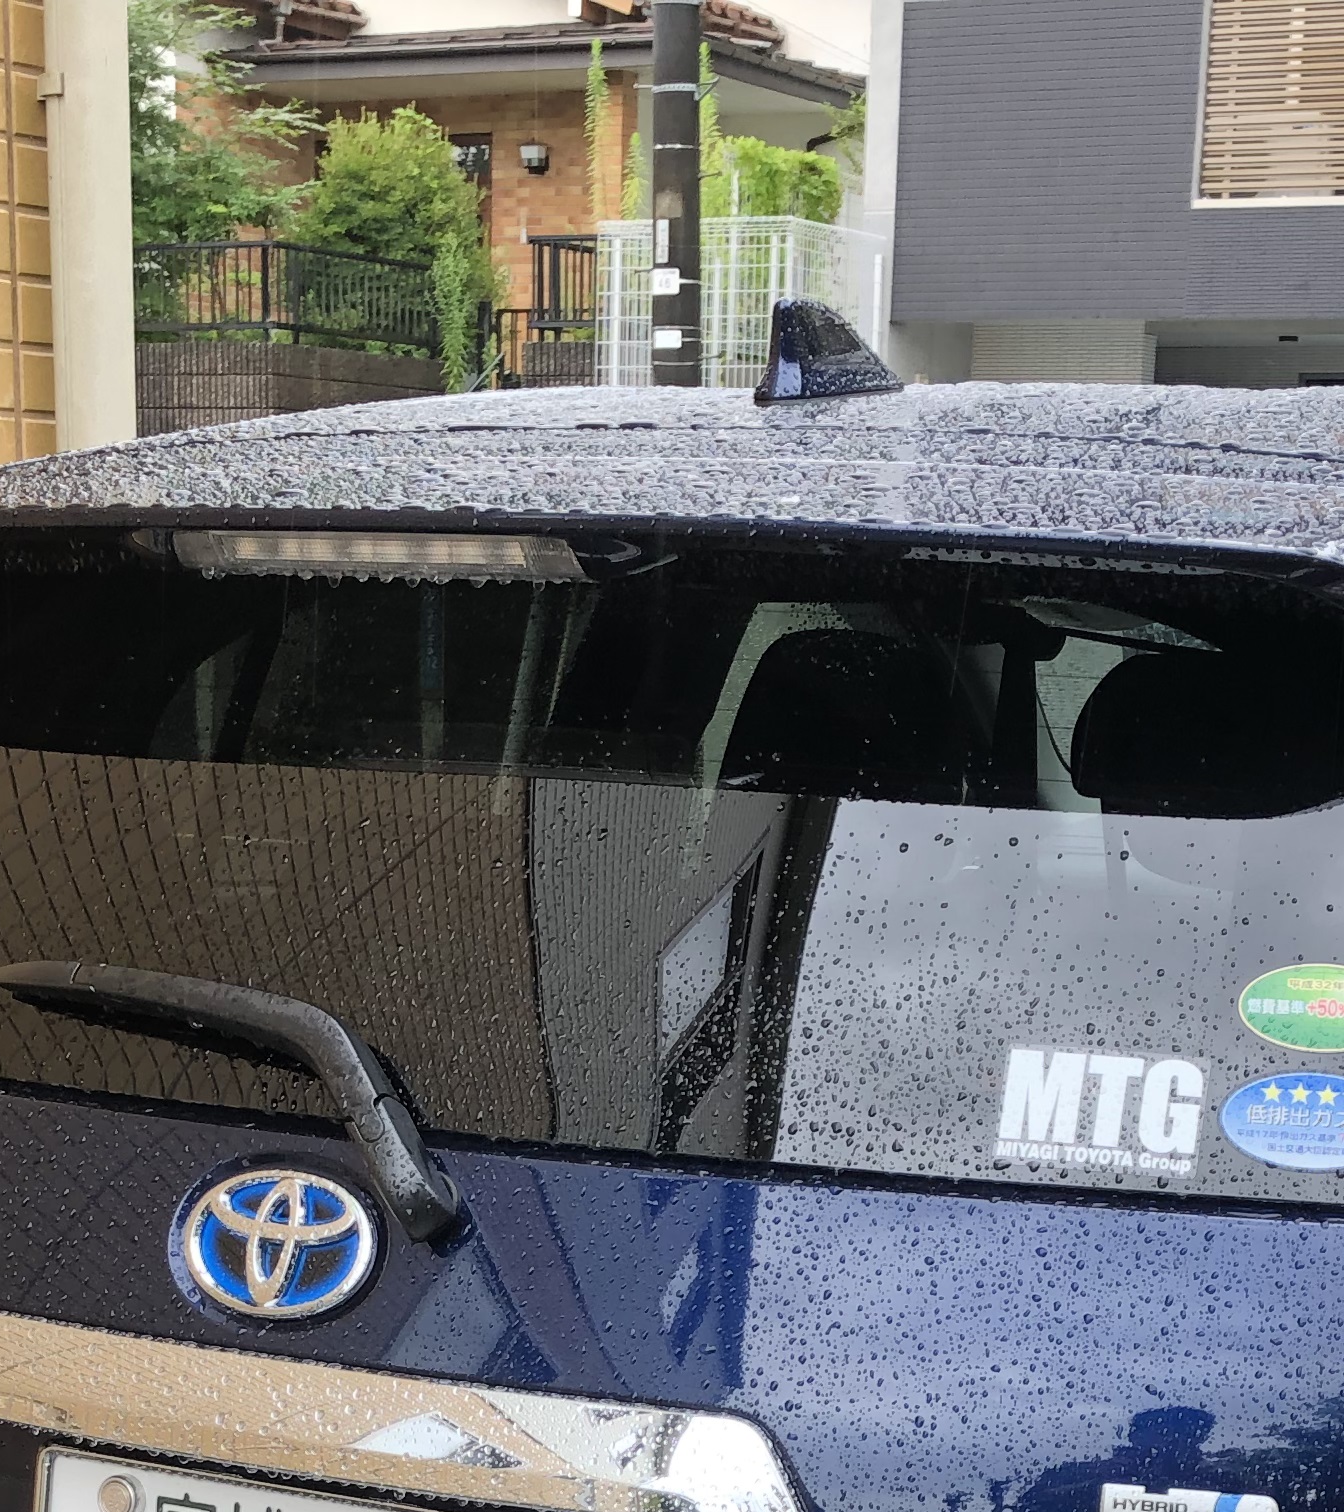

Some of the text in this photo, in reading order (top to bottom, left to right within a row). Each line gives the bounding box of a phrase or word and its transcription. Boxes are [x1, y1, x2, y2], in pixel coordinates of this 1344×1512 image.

[998, 1048, 1204, 1155] MTG
[996, 1141, 1191, 1174] MIYAGI TOYOTA Group
